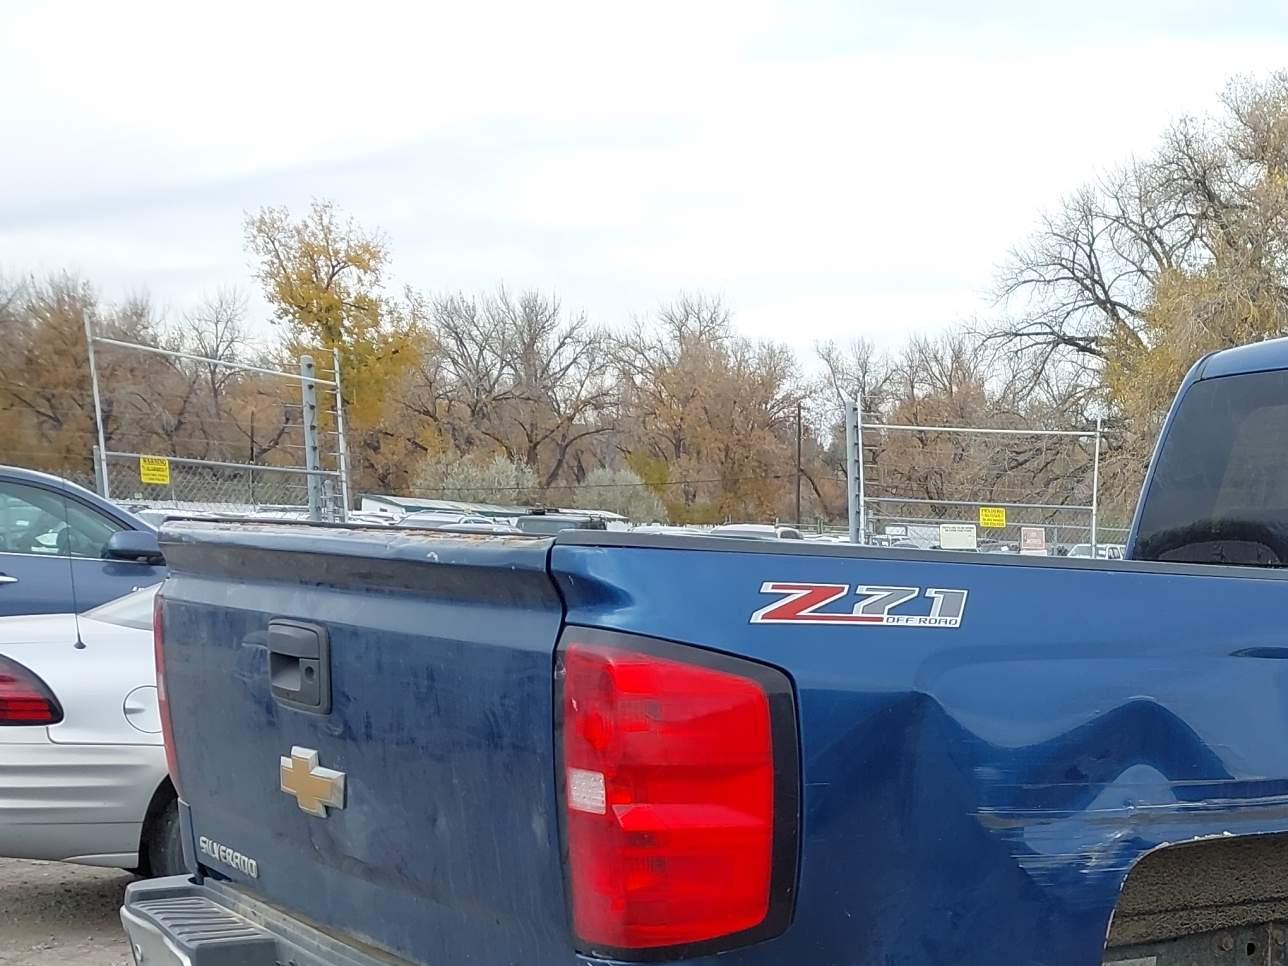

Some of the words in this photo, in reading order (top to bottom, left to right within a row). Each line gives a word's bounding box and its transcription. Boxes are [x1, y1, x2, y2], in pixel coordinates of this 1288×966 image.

[749, 582, 968, 627] Z71
[886, 616, 914, 625] OFF
[917, 617, 958, 626] ROAD
[199, 835, 258, 879] SILVERADO
